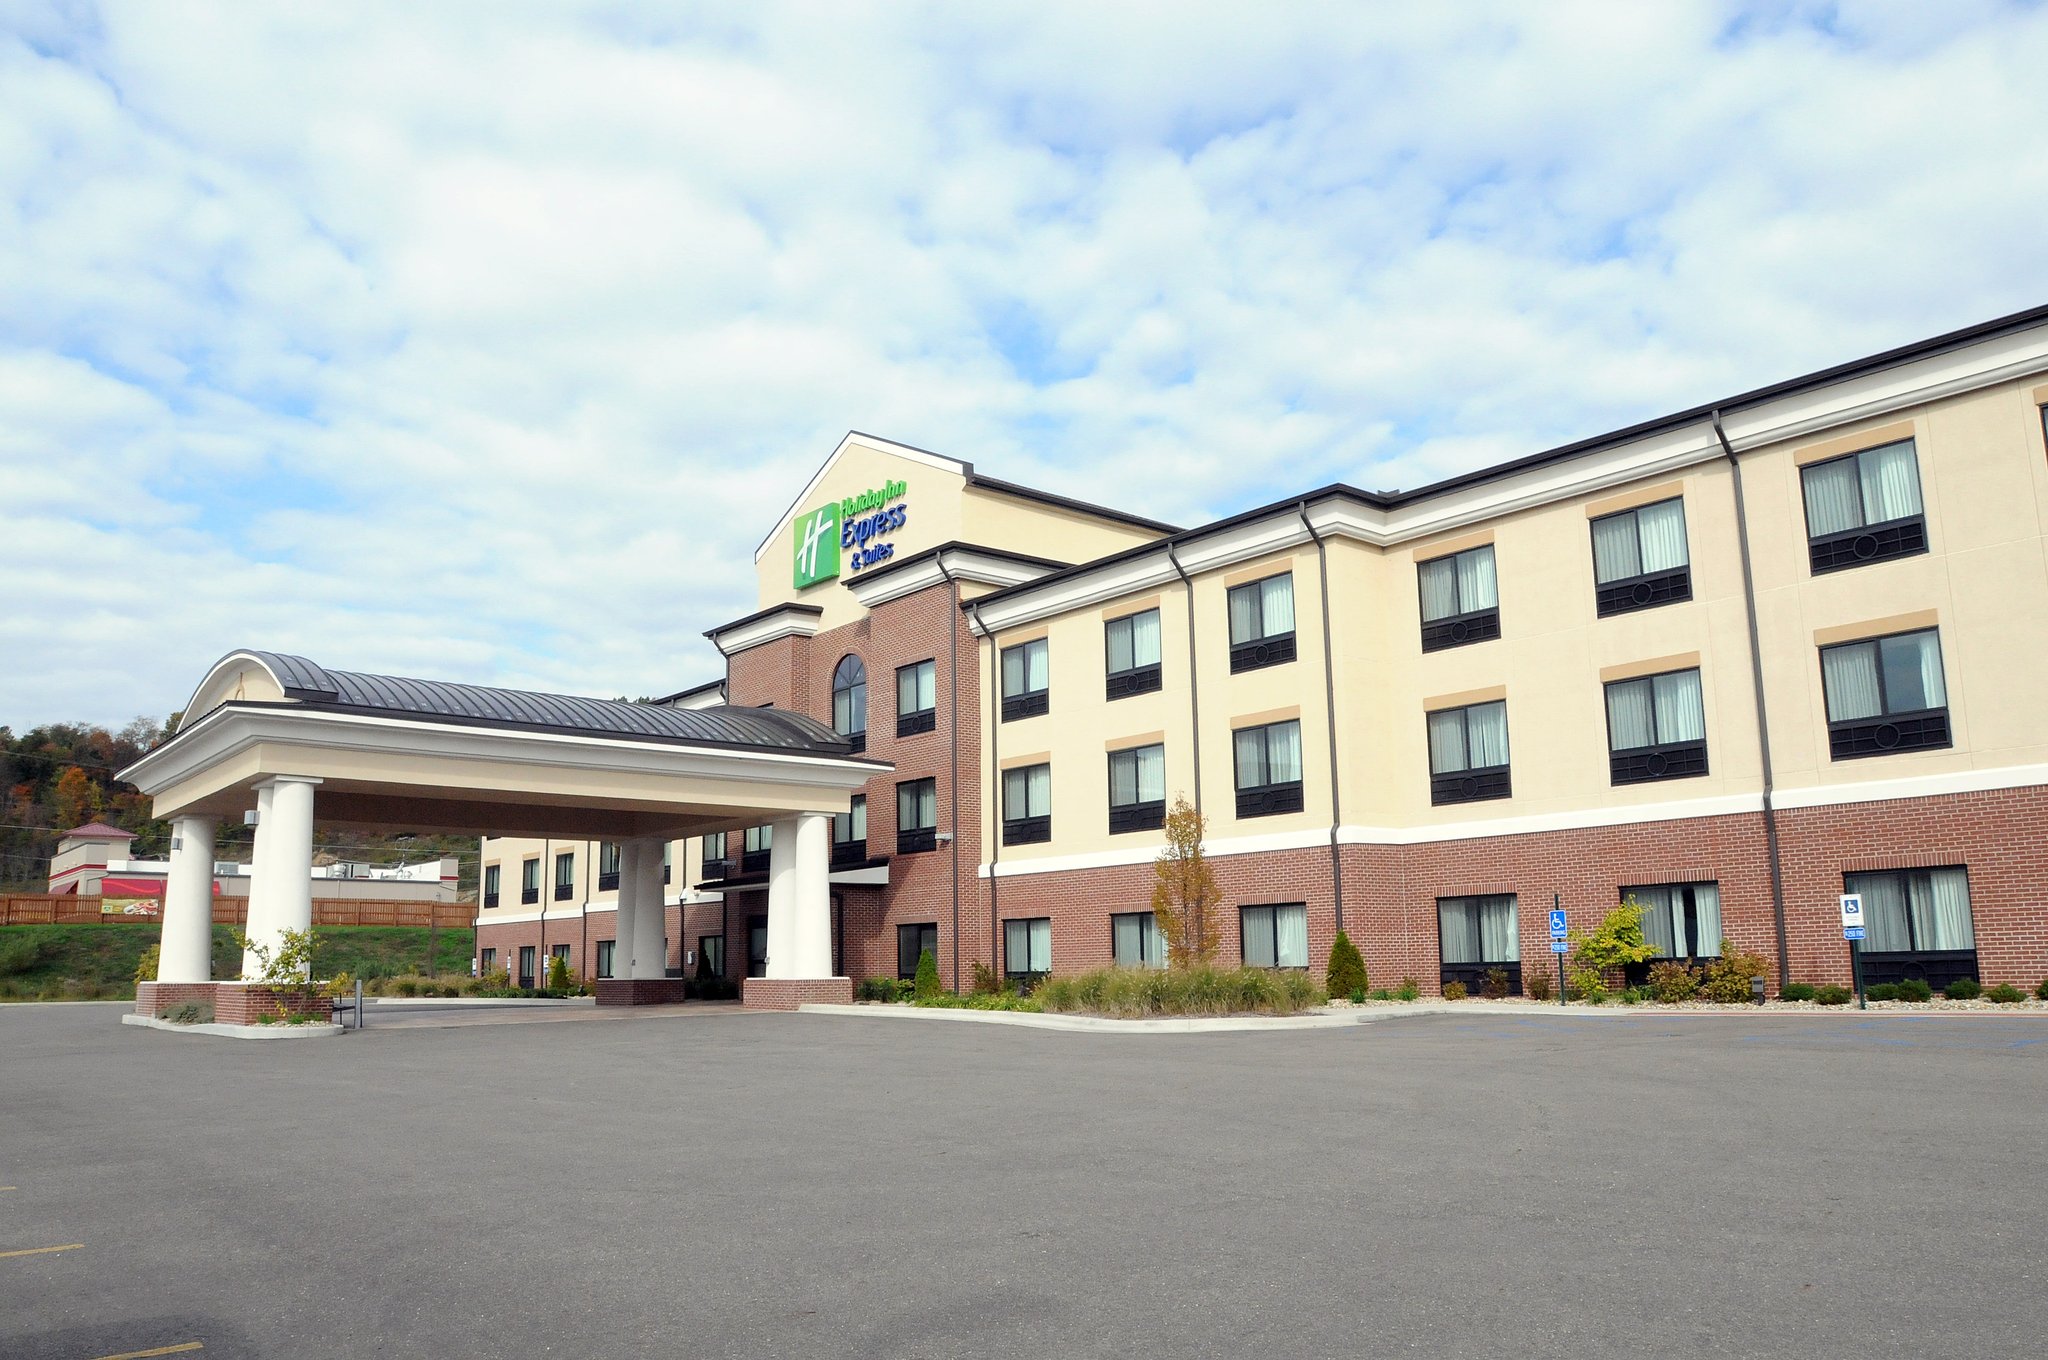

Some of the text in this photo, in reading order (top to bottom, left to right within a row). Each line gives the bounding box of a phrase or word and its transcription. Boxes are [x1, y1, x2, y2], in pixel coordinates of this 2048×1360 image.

[840, 479, 907, 519] Holiday Inn
[840, 503, 907, 548] Express
[851, 543, 894, 570] & Suites
